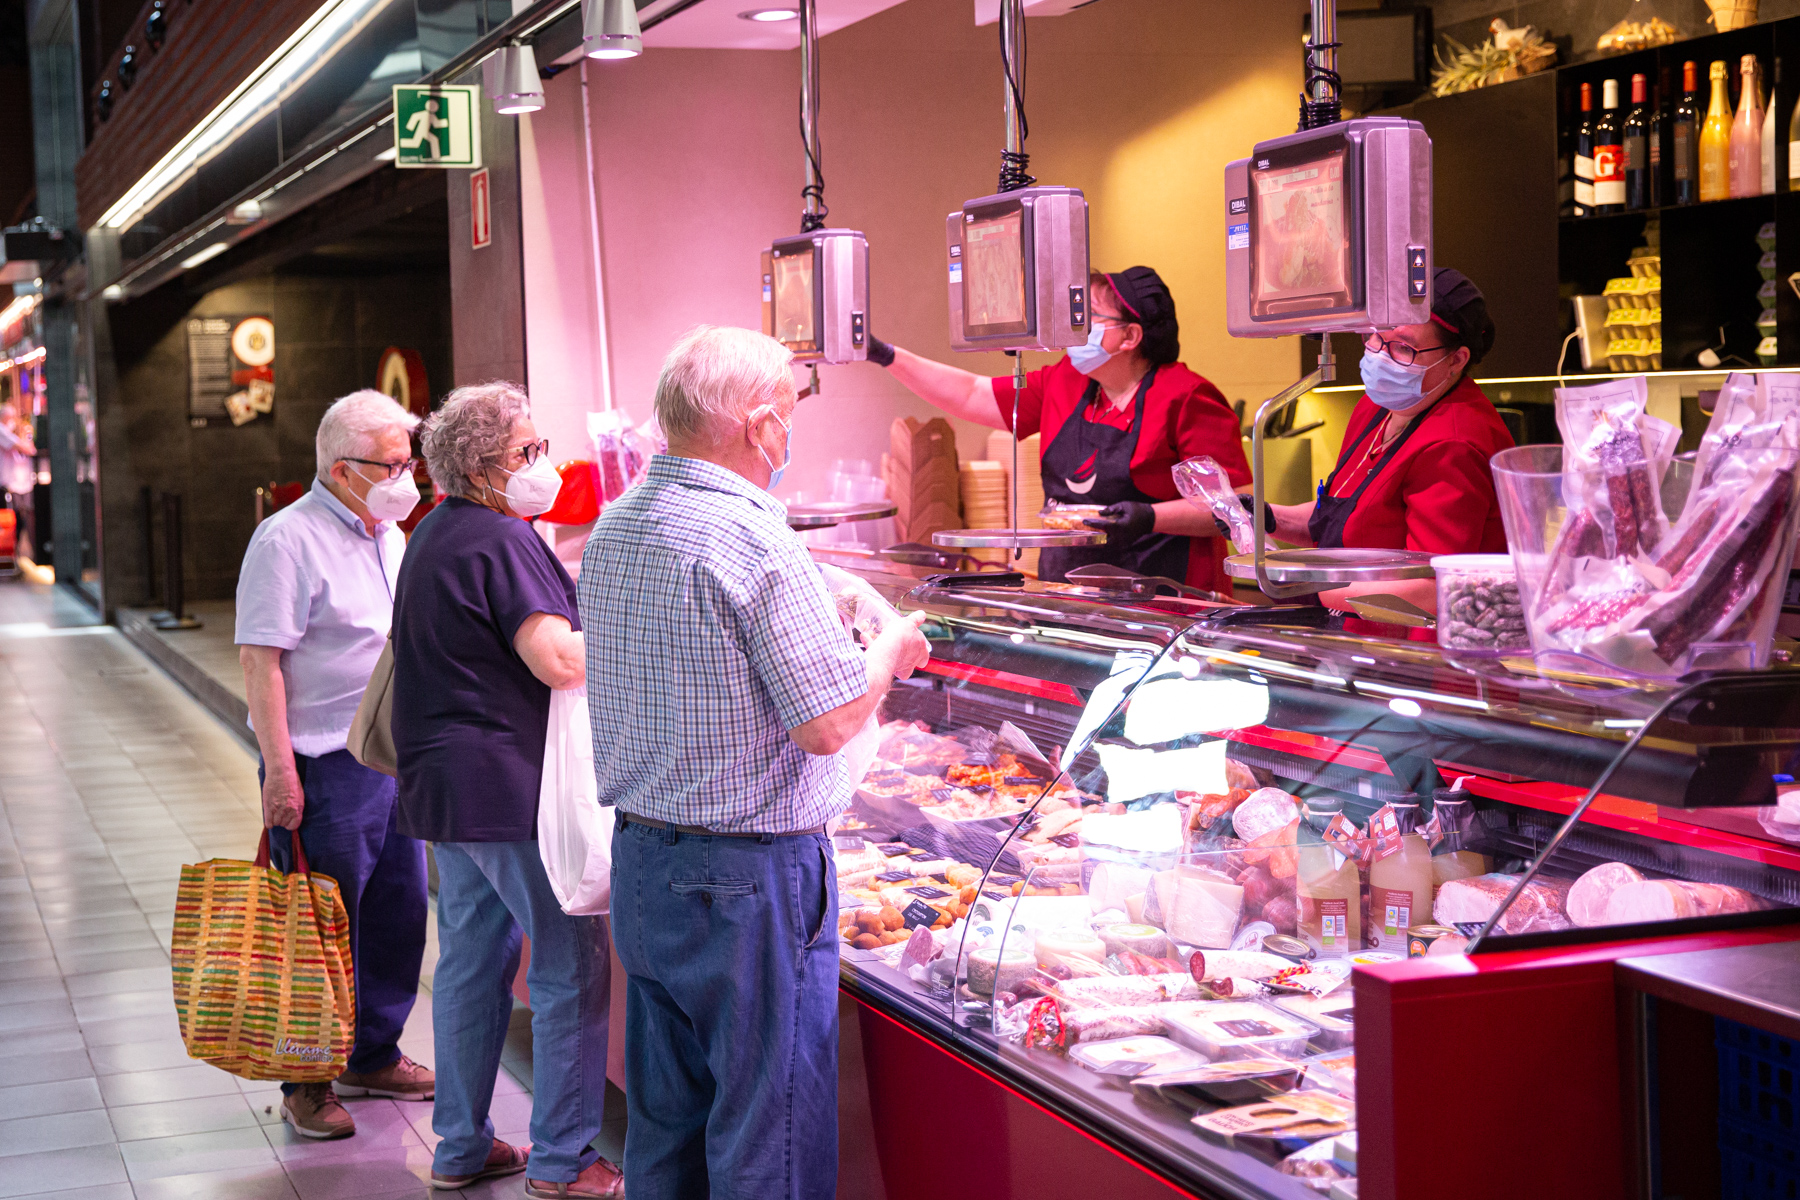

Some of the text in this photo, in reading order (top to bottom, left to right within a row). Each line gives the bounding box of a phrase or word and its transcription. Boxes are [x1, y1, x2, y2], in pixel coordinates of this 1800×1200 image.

[1257, 159, 1270, 167] DIBAL
[1594, 151, 1616, 178] G
[1231, 200, 1246, 209] DIBAL
[276, 1038, 331, 1055] Llévame
[300, 1054, 334, 1063] contigo
